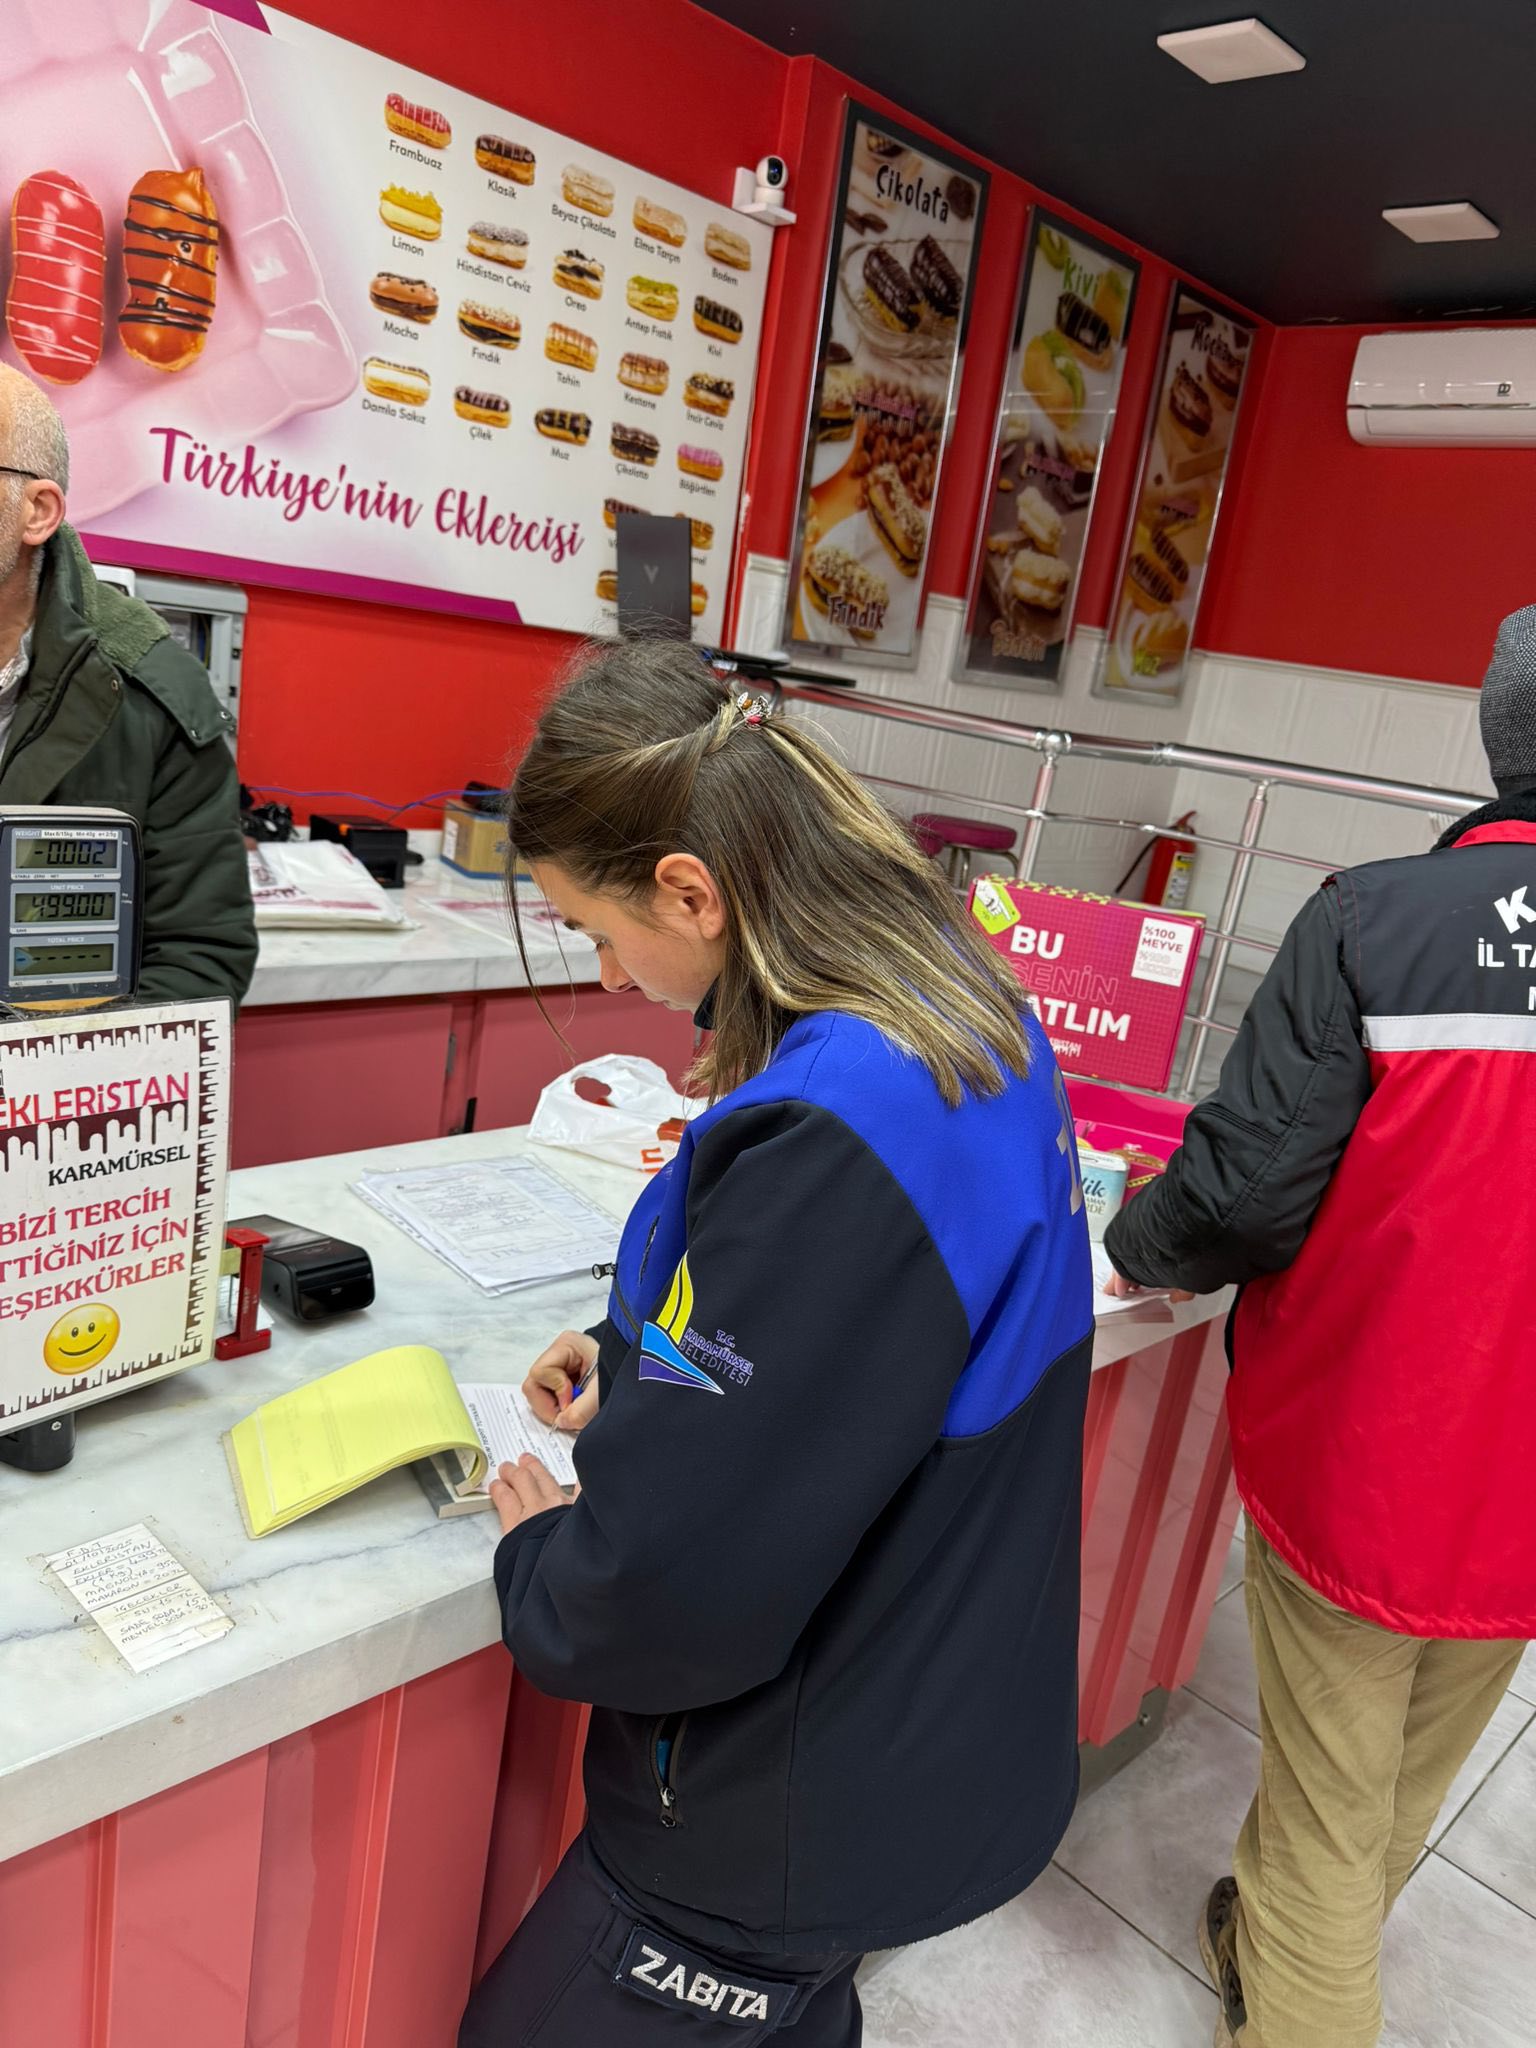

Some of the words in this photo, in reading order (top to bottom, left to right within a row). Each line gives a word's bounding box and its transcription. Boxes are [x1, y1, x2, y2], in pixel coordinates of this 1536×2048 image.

[389, 139, 443, 171] Frambuaz
[487, 179, 518, 200] Klasik
[876, 164, 950, 224] Çikolata
[551, 204, 578, 224] Beyaz
[580, 216, 617, 239] Çikolata
[391, 235, 425, 257] Limon
[634, 236, 655, 254] Elma
[456, 259, 505, 285] Hindistan
[506, 275, 532, 294] Ceviz
[711, 267, 739, 286] Badem
[1062, 257, 1102, 300] Kivi
[565, 296, 588, 312] Oreo
[382, 321, 420, 341] Mocha
[625, 317, 651, 334] Antep
[471, 347, 502, 365] Fındık
[708, 344, 723, 357] Kivi
[556, 371, 581, 387] Tahin
[362, 399, 397, 417] Damla
[399, 408, 426, 425] Sakız
[623, 391, 657, 410] Kestane
[469, 426, 493, 441] Çilek
[551, 447, 570, 461] Muz
[615, 463, 649, 480] Çikolata
[149, 427, 423, 529] Türkiye'nin
[434, 488, 585, 564] Eklercisi
[679, 479, 717, 498] Böğürtlen
[827, 594, 886, 630] Fındık
[1010, 924, 1065, 960] BU
[1144, 926, 1176, 940] %100
[1141, 937, 1184, 954] MEYVE
[1477, 937, 1505, 967] İL
[1008, 956, 1119, 1006] SENİN
[1024, 994, 1132, 1042] ATLIM
[48, 1145, 191, 1187] KARAMÜRSEL
[0, 1206, 57, 1246] BİZİ
[64, 1186, 172, 1232] TERCİH
[0, 1233, 125, 1284] TTİĞİNİZ
[131, 1217, 190, 1254] İÇİN
[0, 1252, 186, 1322] EŞEKKÜRLER
[715, 1329, 736, 1349] T.C.
[683, 1327, 755, 1376] KARAMÜRSEL
[630, 1944, 769, 2020] ZABITA
